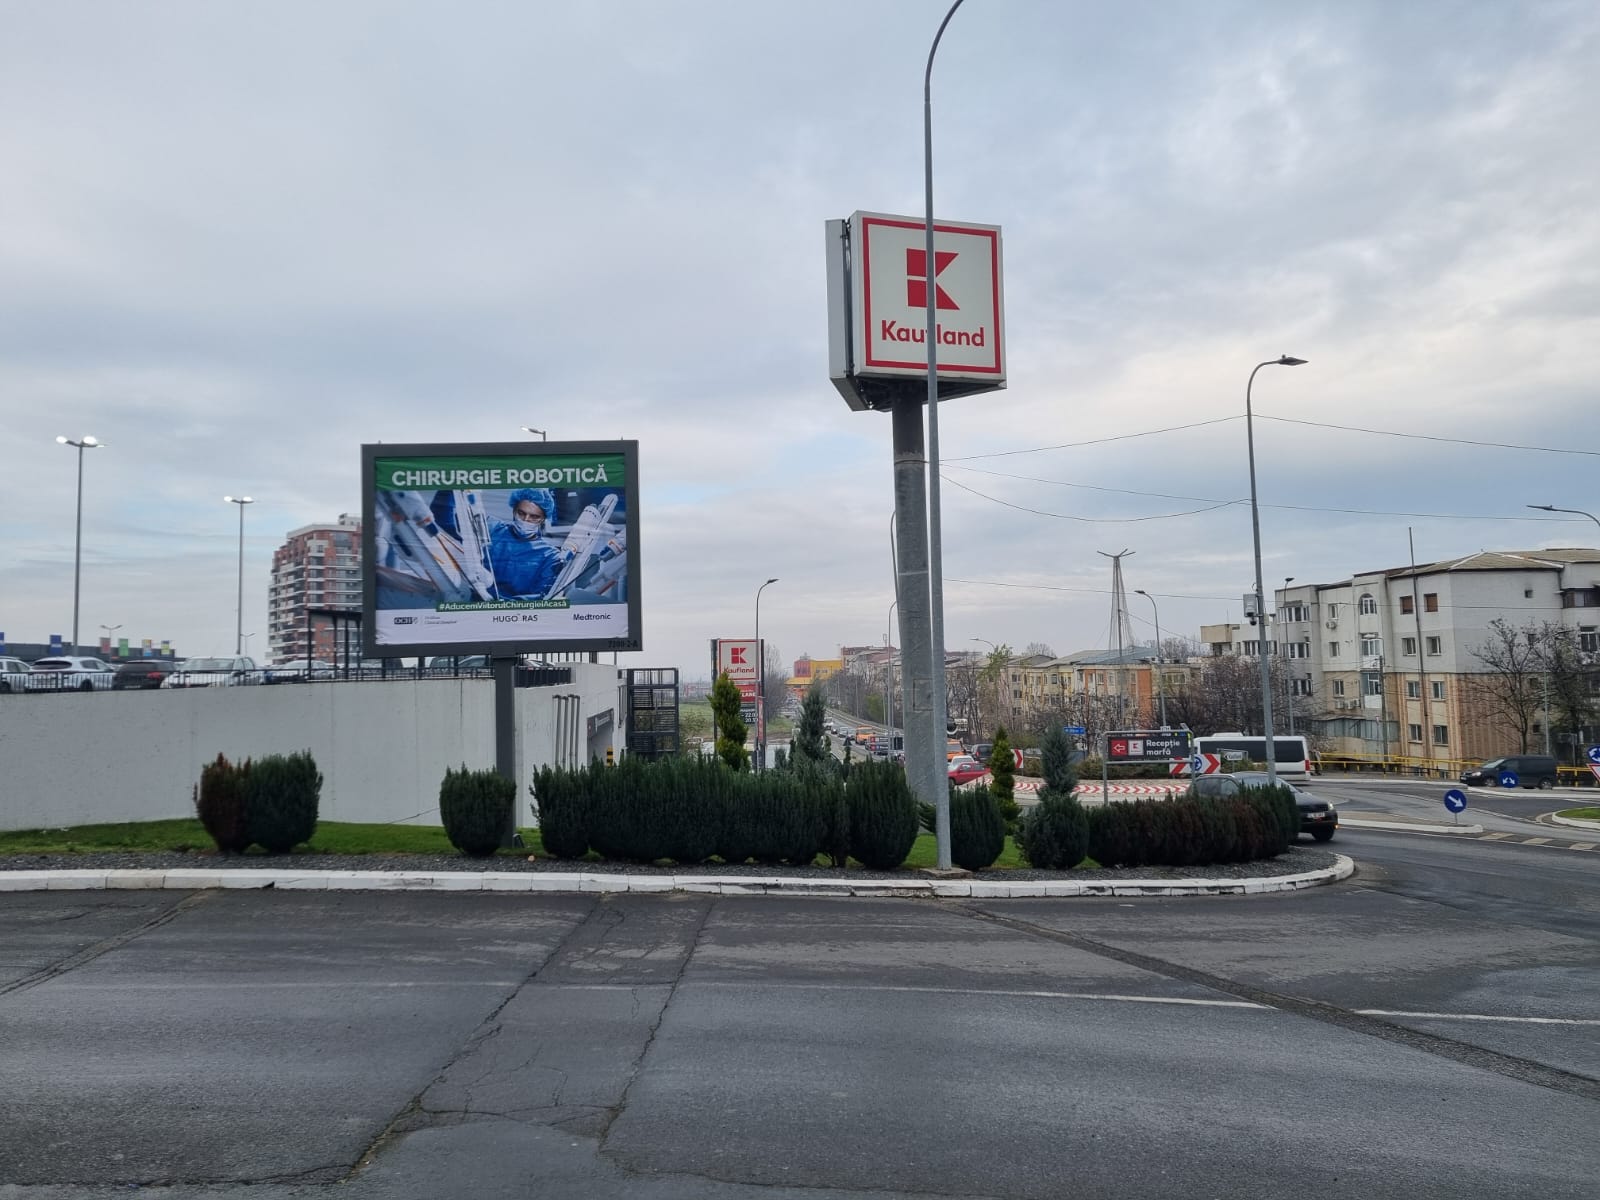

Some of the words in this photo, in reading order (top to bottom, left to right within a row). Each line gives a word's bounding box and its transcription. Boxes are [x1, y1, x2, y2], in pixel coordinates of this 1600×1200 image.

[881, 319, 985, 347] Kauland
[391, 469, 502, 487] CHIRURGIE
[506, 464, 609, 484] ROBOTICĂ
[492, 615, 519, 623] HUGO
[522, 614, 538, 622] RAS
[573, 613, 611, 621] Medtronic
[724, 666, 755, 674] Kaufland
[1146, 740, 1180, 748] Recepție
